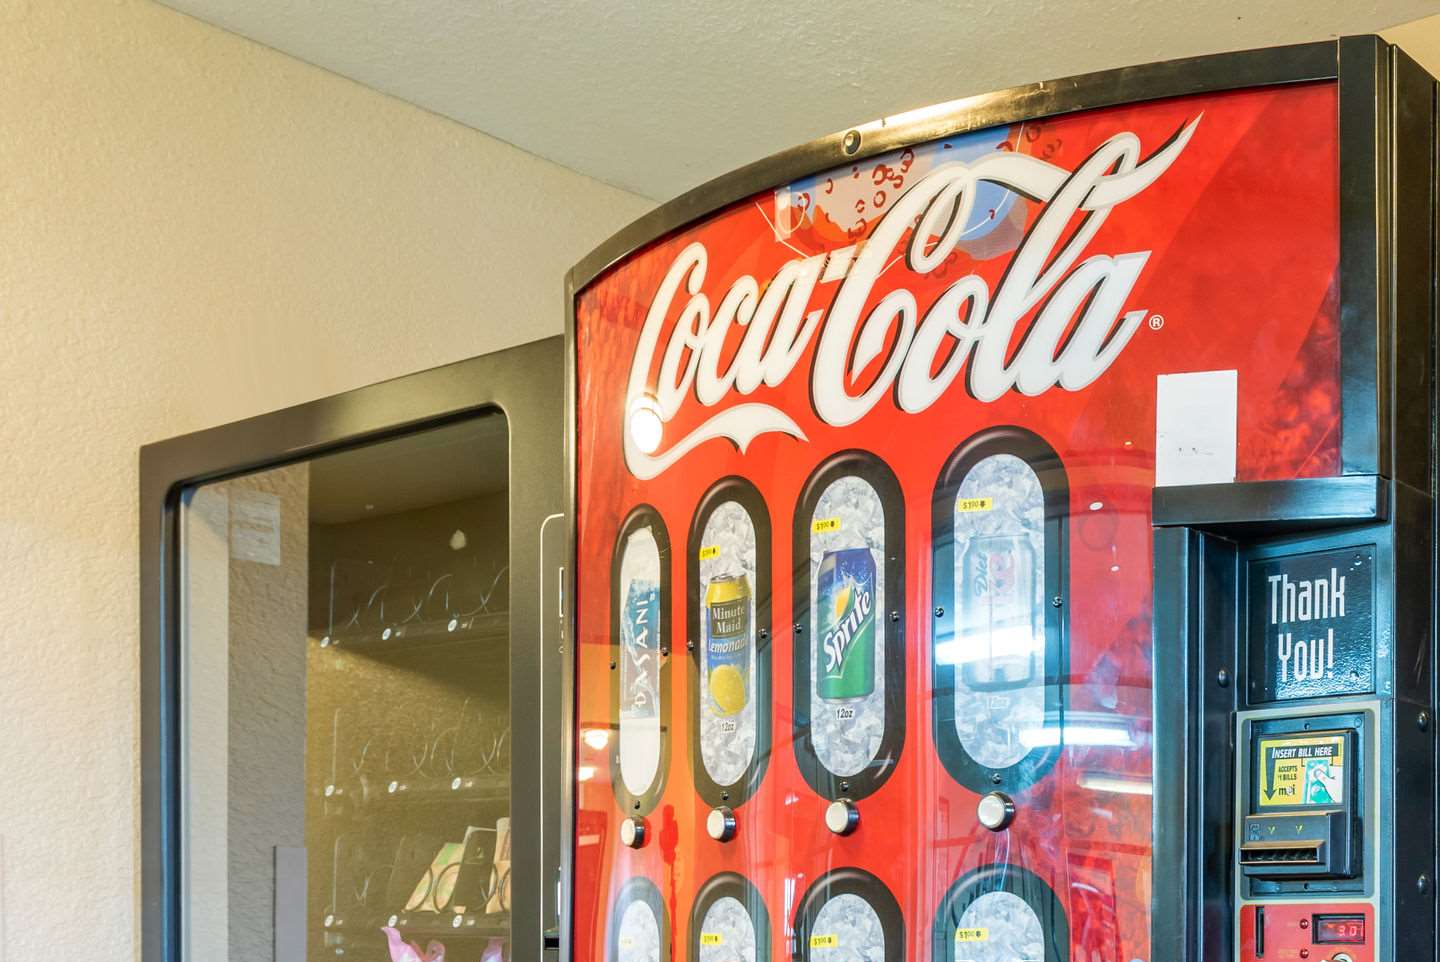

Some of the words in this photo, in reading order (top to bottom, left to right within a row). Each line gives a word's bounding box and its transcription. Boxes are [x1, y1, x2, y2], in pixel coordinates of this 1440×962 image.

[623, 111, 1204, 480] Coca-Cola
[712, 606, 745, 621] Minute
[1268, 567, 1346, 625] Thank
[634, 600, 649, 708] DASANI
[716, 621, 742, 634] Maid
[823, 591, 871, 673] Sprite
[1277, 628, 1335, 682] You!
[836, 708, 853, 719] 12oz
[1271, 747, 1297, 759] INSERT
[1298, 747, 1312, 757] BILL
[1314, 746, 1333, 756] HERE
